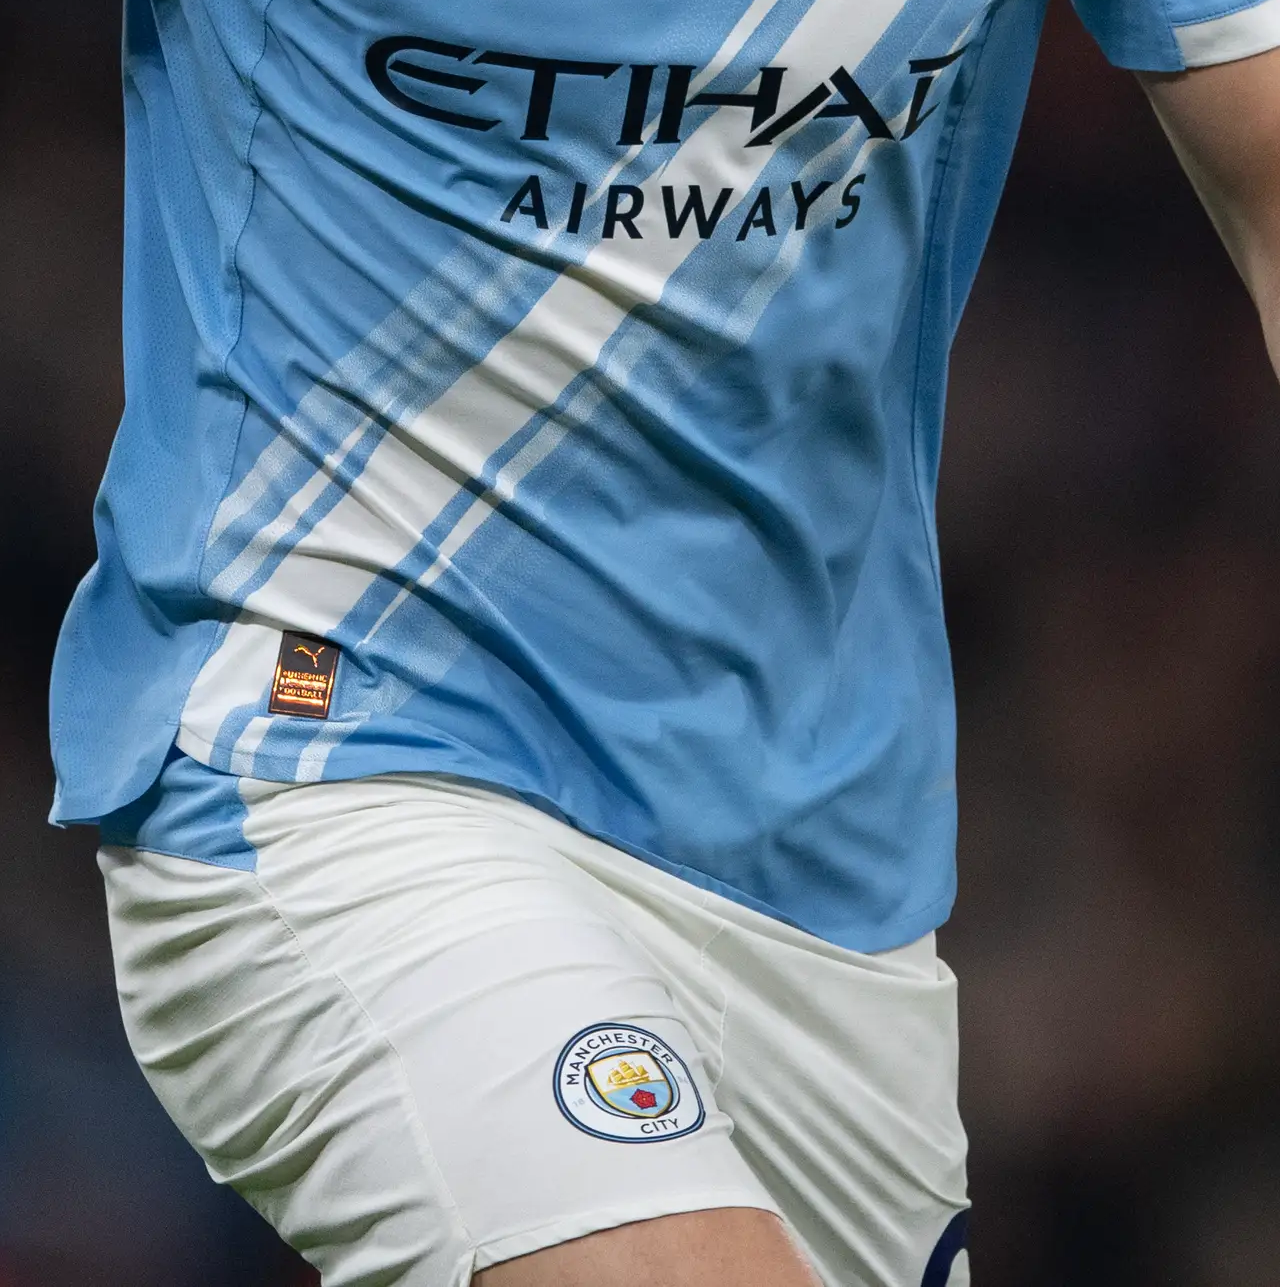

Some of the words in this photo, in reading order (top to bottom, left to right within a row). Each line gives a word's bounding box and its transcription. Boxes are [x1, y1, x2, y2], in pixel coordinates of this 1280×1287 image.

[500, 172, 867, 242] AIRWAYS
[566, 1032, 674, 1086] MANCHESTER
[640, 1117, 680, 1134] CITY
